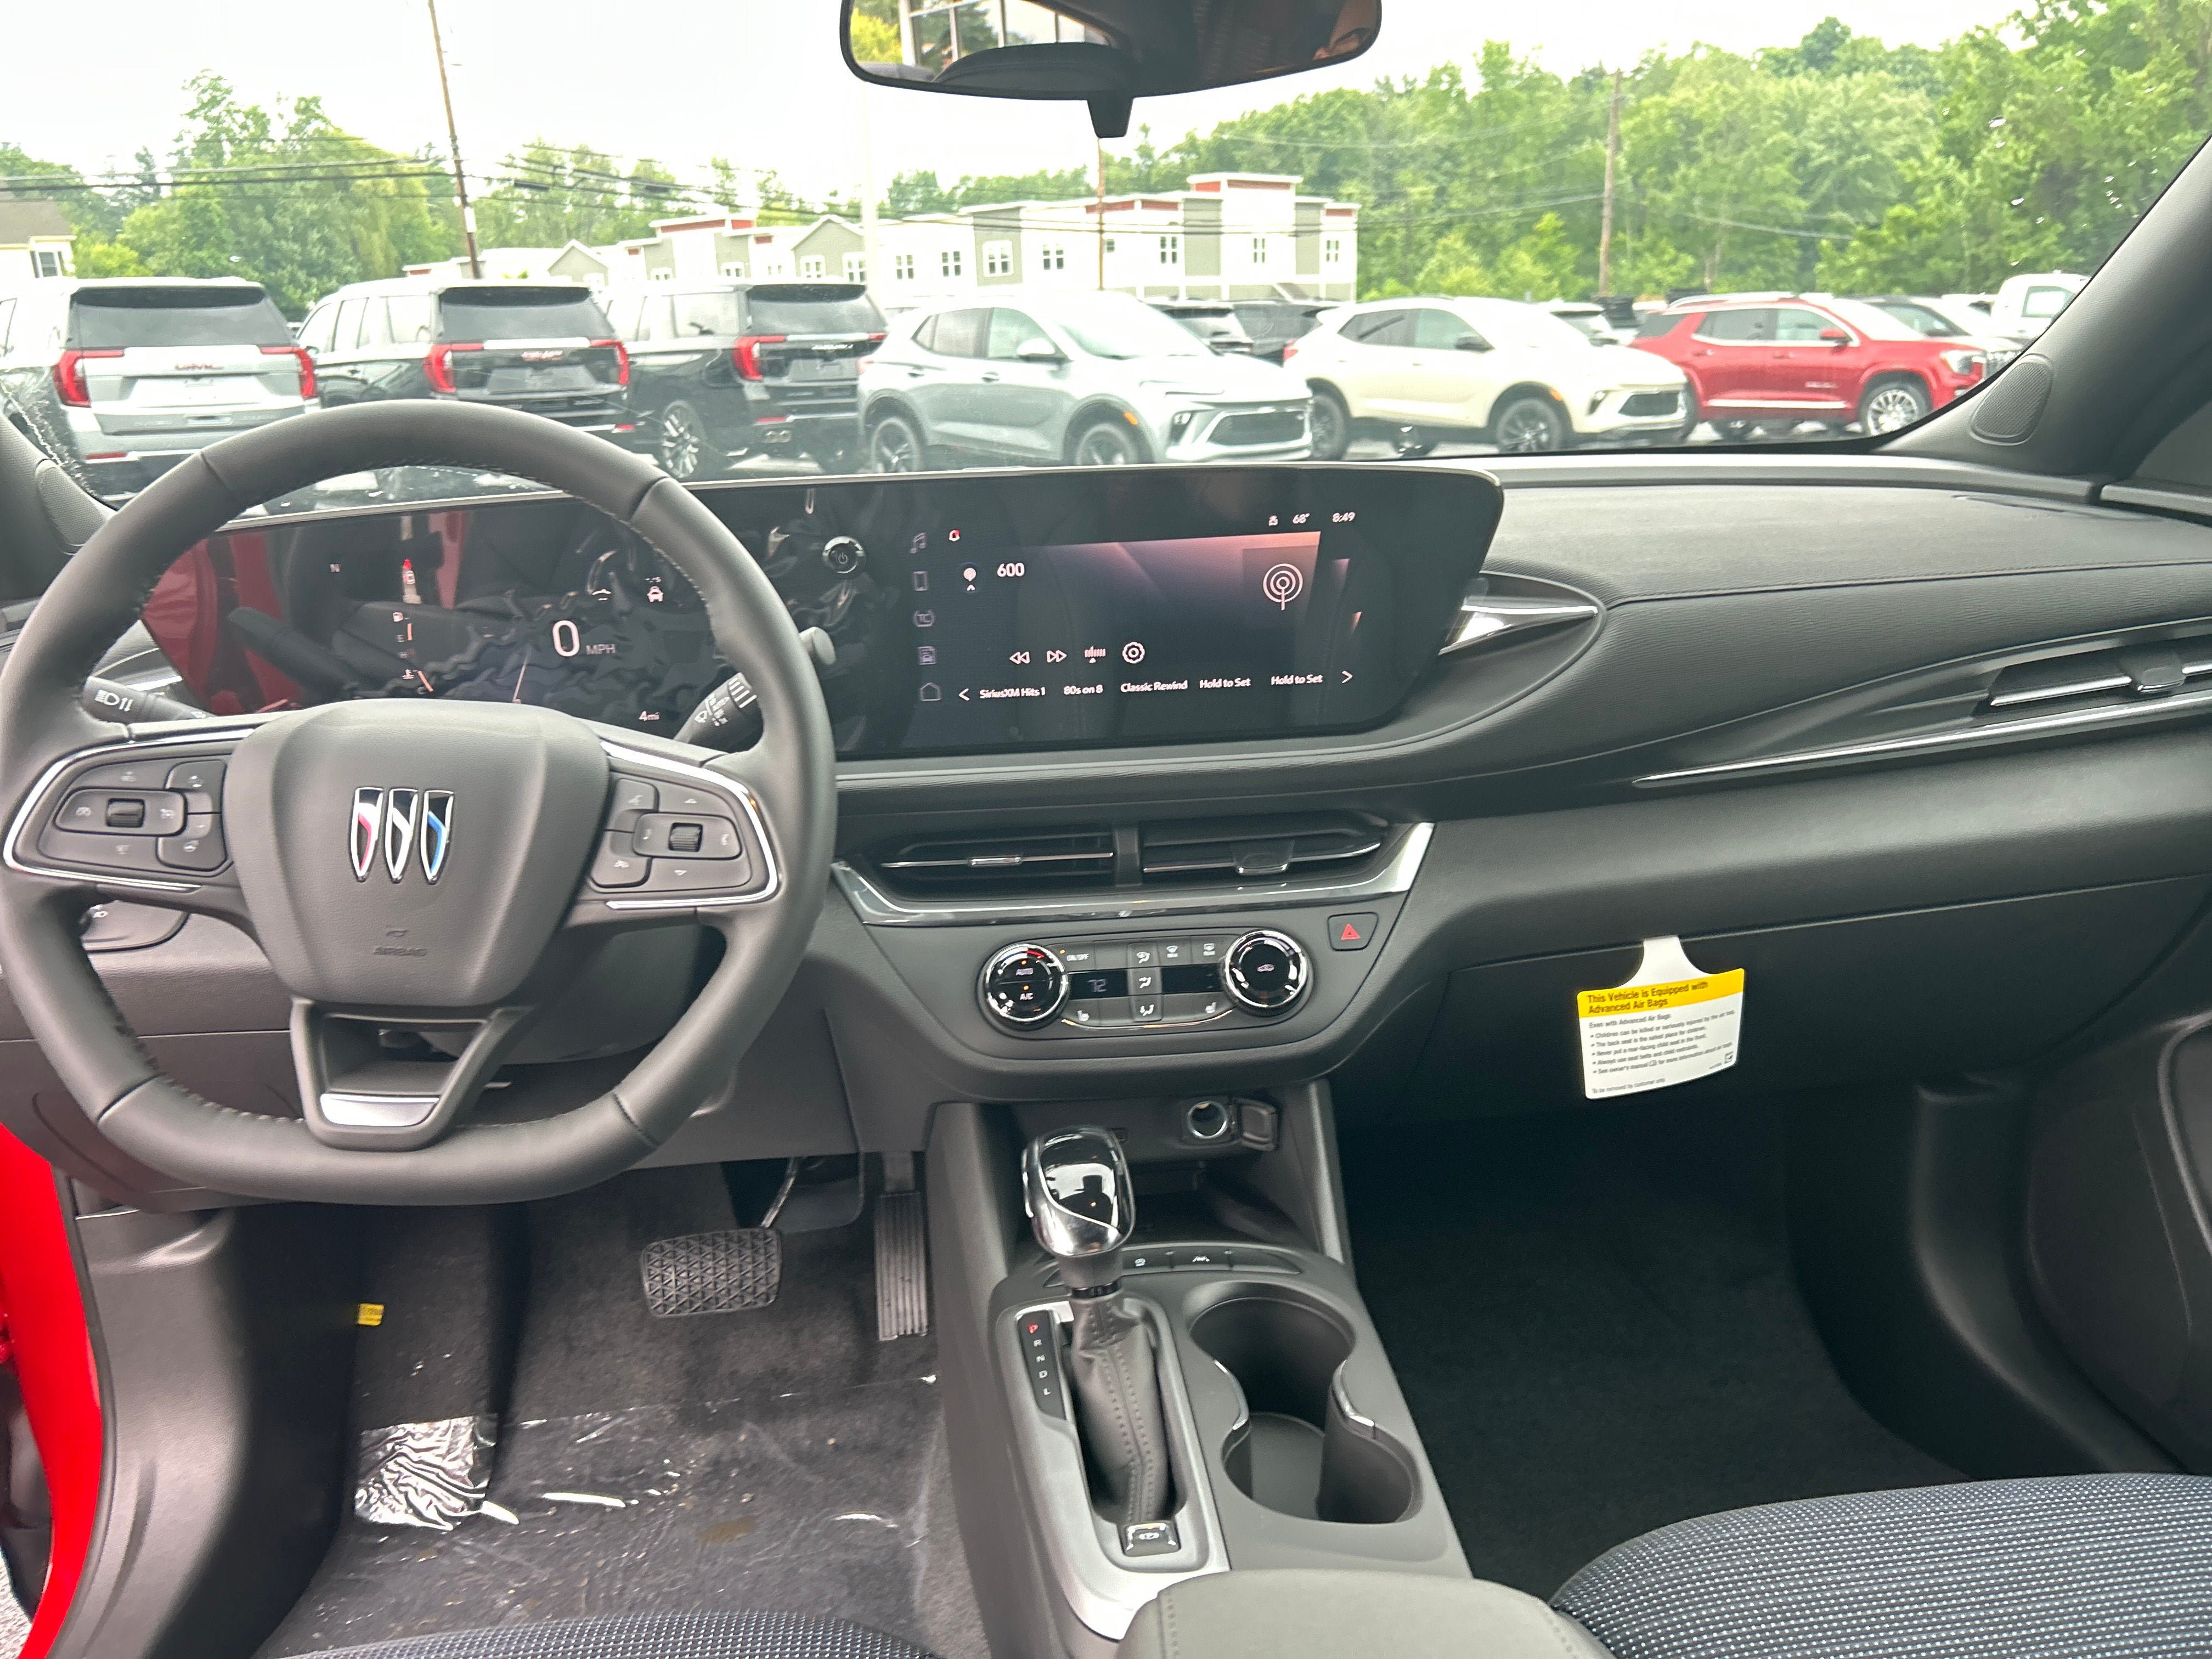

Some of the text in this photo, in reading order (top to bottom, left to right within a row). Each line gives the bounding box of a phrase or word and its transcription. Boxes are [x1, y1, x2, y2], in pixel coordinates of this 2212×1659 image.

[1332, 512, 1355, 522] 8:49
[997, 562, 1025, 577] 600
[585, 644, 616, 655] MPH
[1199, 678, 1251, 689] Hold to Set
[1271, 674, 1323, 685] Hold to Set
[1063, 686, 1082, 696] 80s
[1096, 685, 1103, 693] 8
[1120, 680, 1188, 693] Classic Rewind
[979, 688, 1019, 699] SiriusXM
[1020, 688, 1040, 697] Hits
[1019, 992, 1034, 1001] A/C
[1588, 994, 1606, 1003] This
[1608, 991, 1639, 1001] Vehicle
[1651, 984, 1689, 996] Equipped
[1691, 981, 1708, 990] with
[1589, 998, 1668, 1014] Advanced Air Bags
[1619, 1017, 1646, 1025] Advanced
[1028, 1323, 1039, 1334] P
[1036, 1355, 1045, 1363] N
[1039, 1370, 1048, 1379] D
[1043, 1387, 1052, 1396] L
